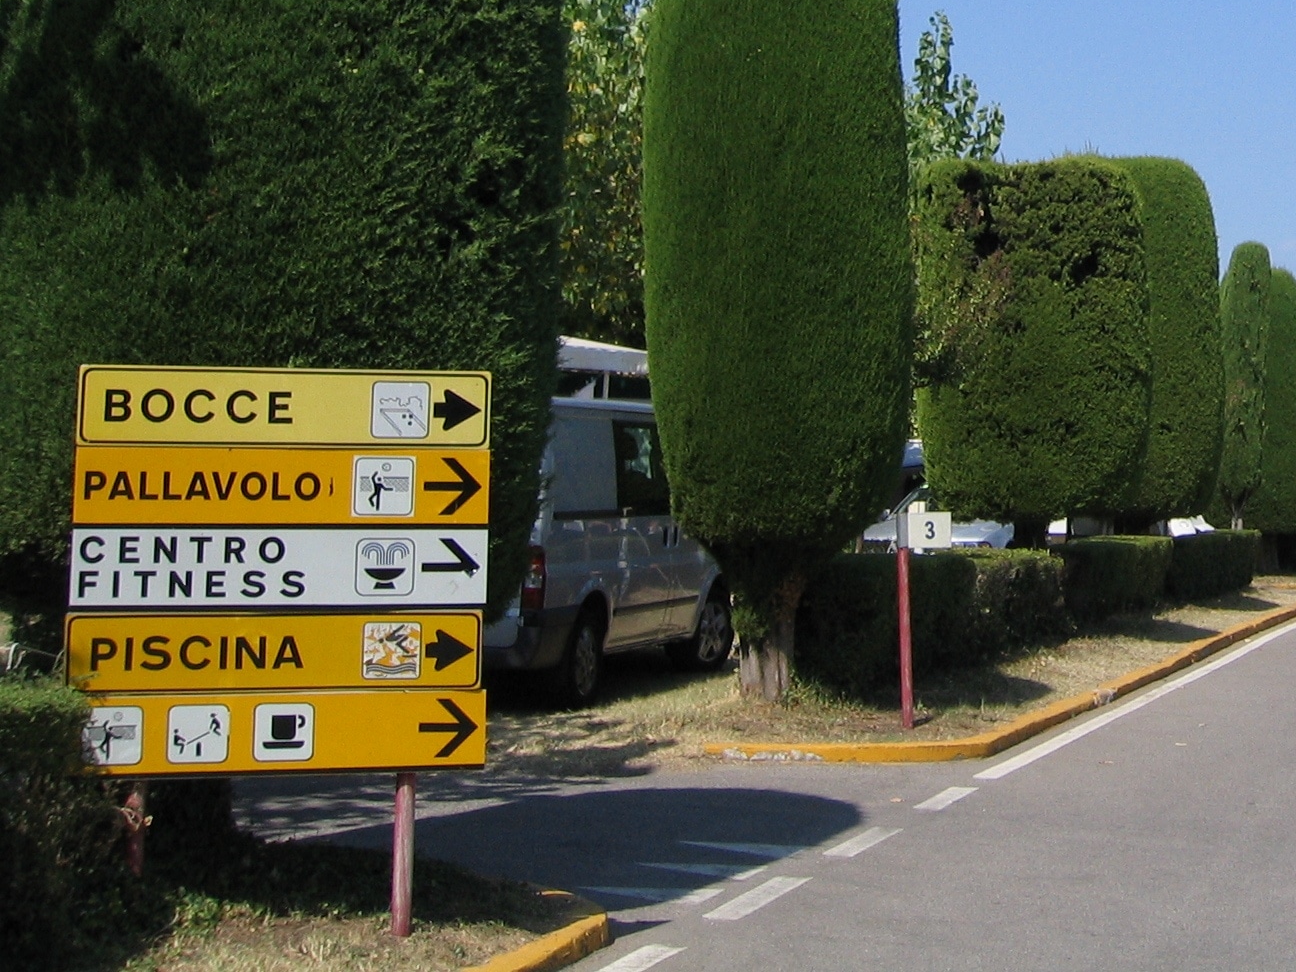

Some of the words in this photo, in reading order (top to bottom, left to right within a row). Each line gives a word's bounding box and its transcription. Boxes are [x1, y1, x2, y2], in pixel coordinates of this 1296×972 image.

[103, 388, 293, 425] BOCCE
[83, 470, 321, 502] PALLAVOLO
[924, 521, 936, 539] 3
[79, 535, 286, 565] CENTRO
[77, 570, 306, 599] FITNESS
[90, 635, 304, 672] PISCINA
